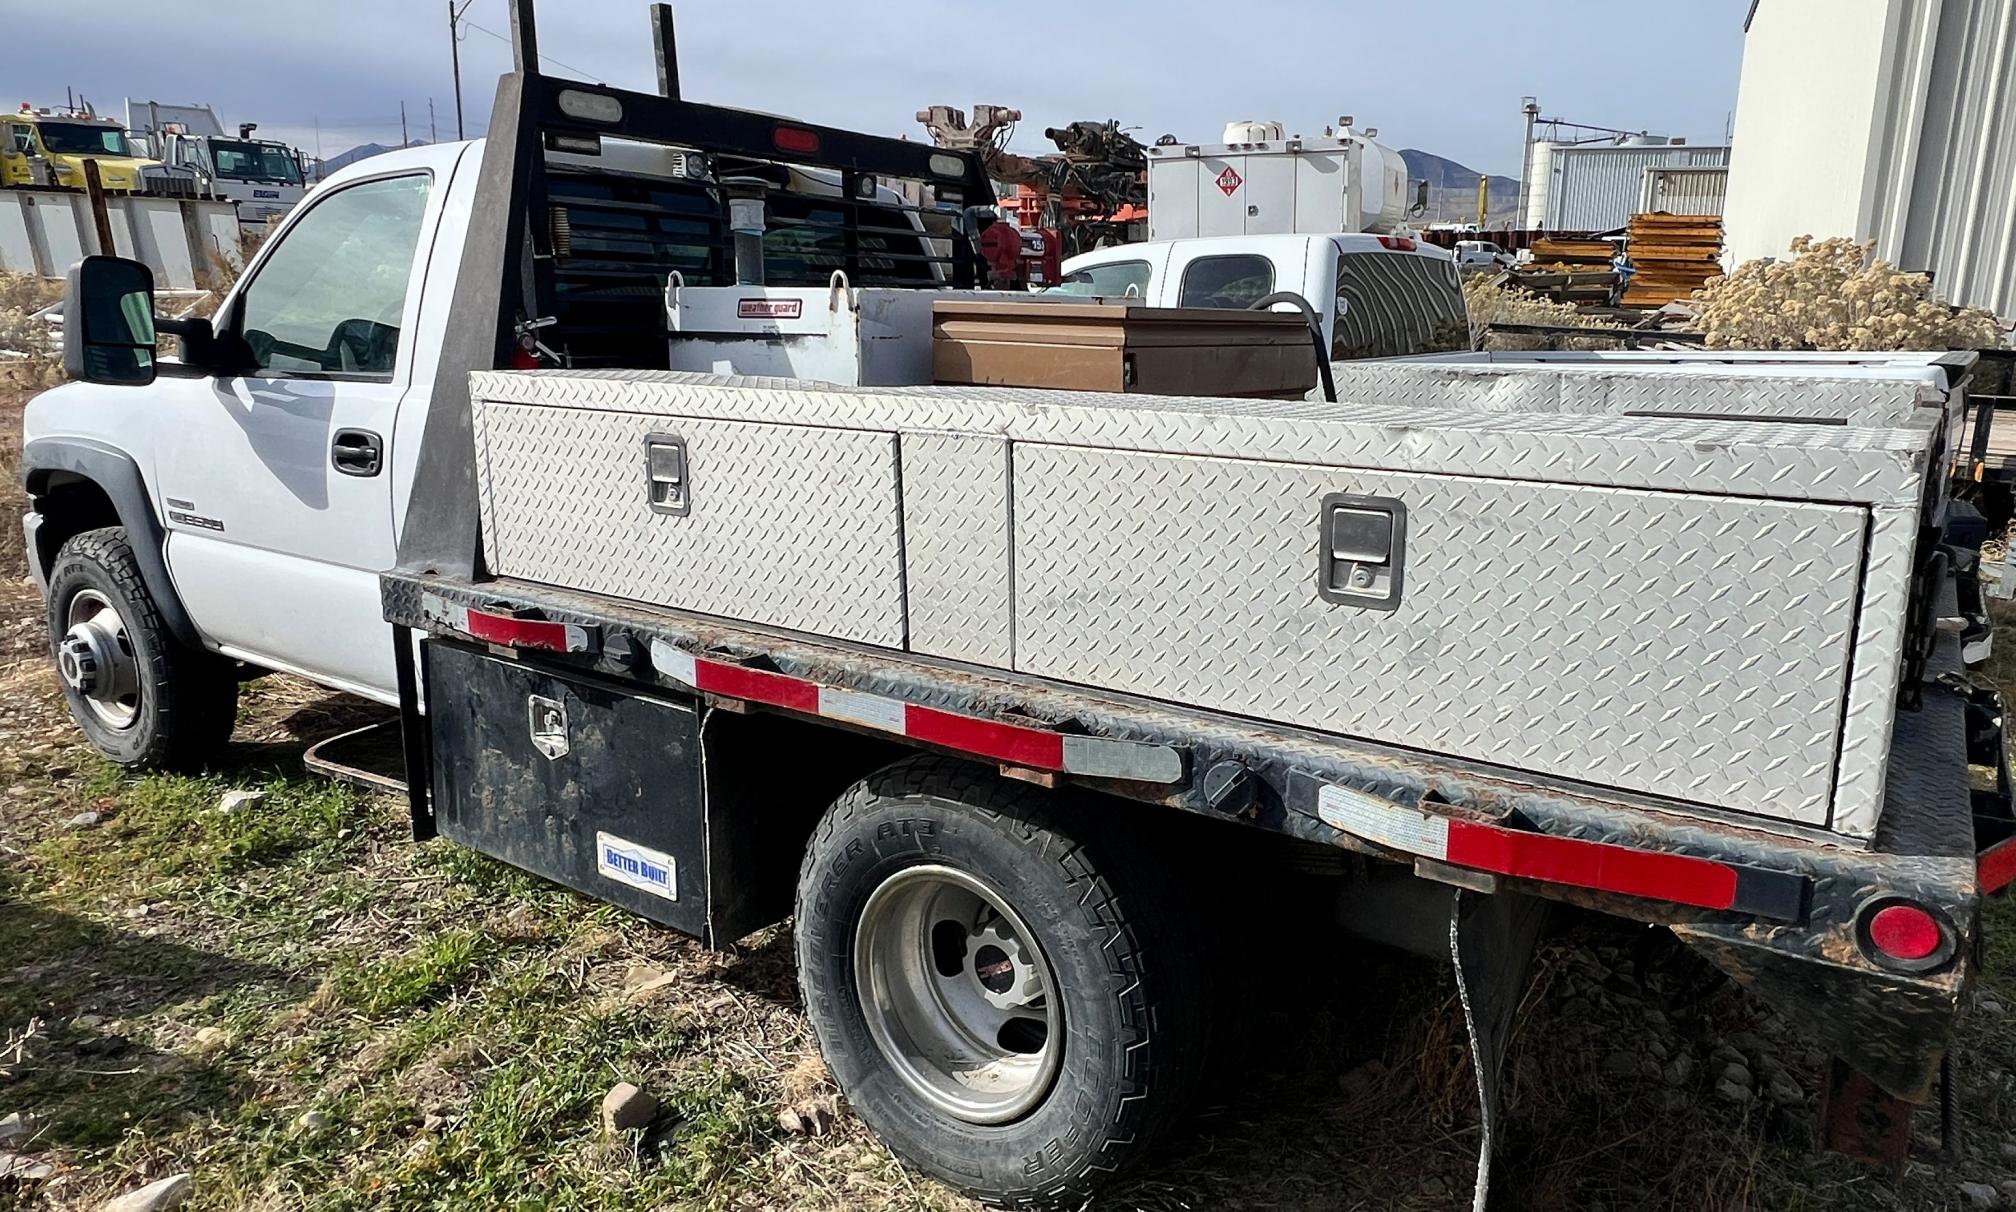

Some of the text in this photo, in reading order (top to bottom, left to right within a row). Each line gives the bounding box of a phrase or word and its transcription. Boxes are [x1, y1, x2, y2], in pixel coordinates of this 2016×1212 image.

[774, 303, 797, 315] guard
[606, 849, 667, 885] BETTER BUILT
